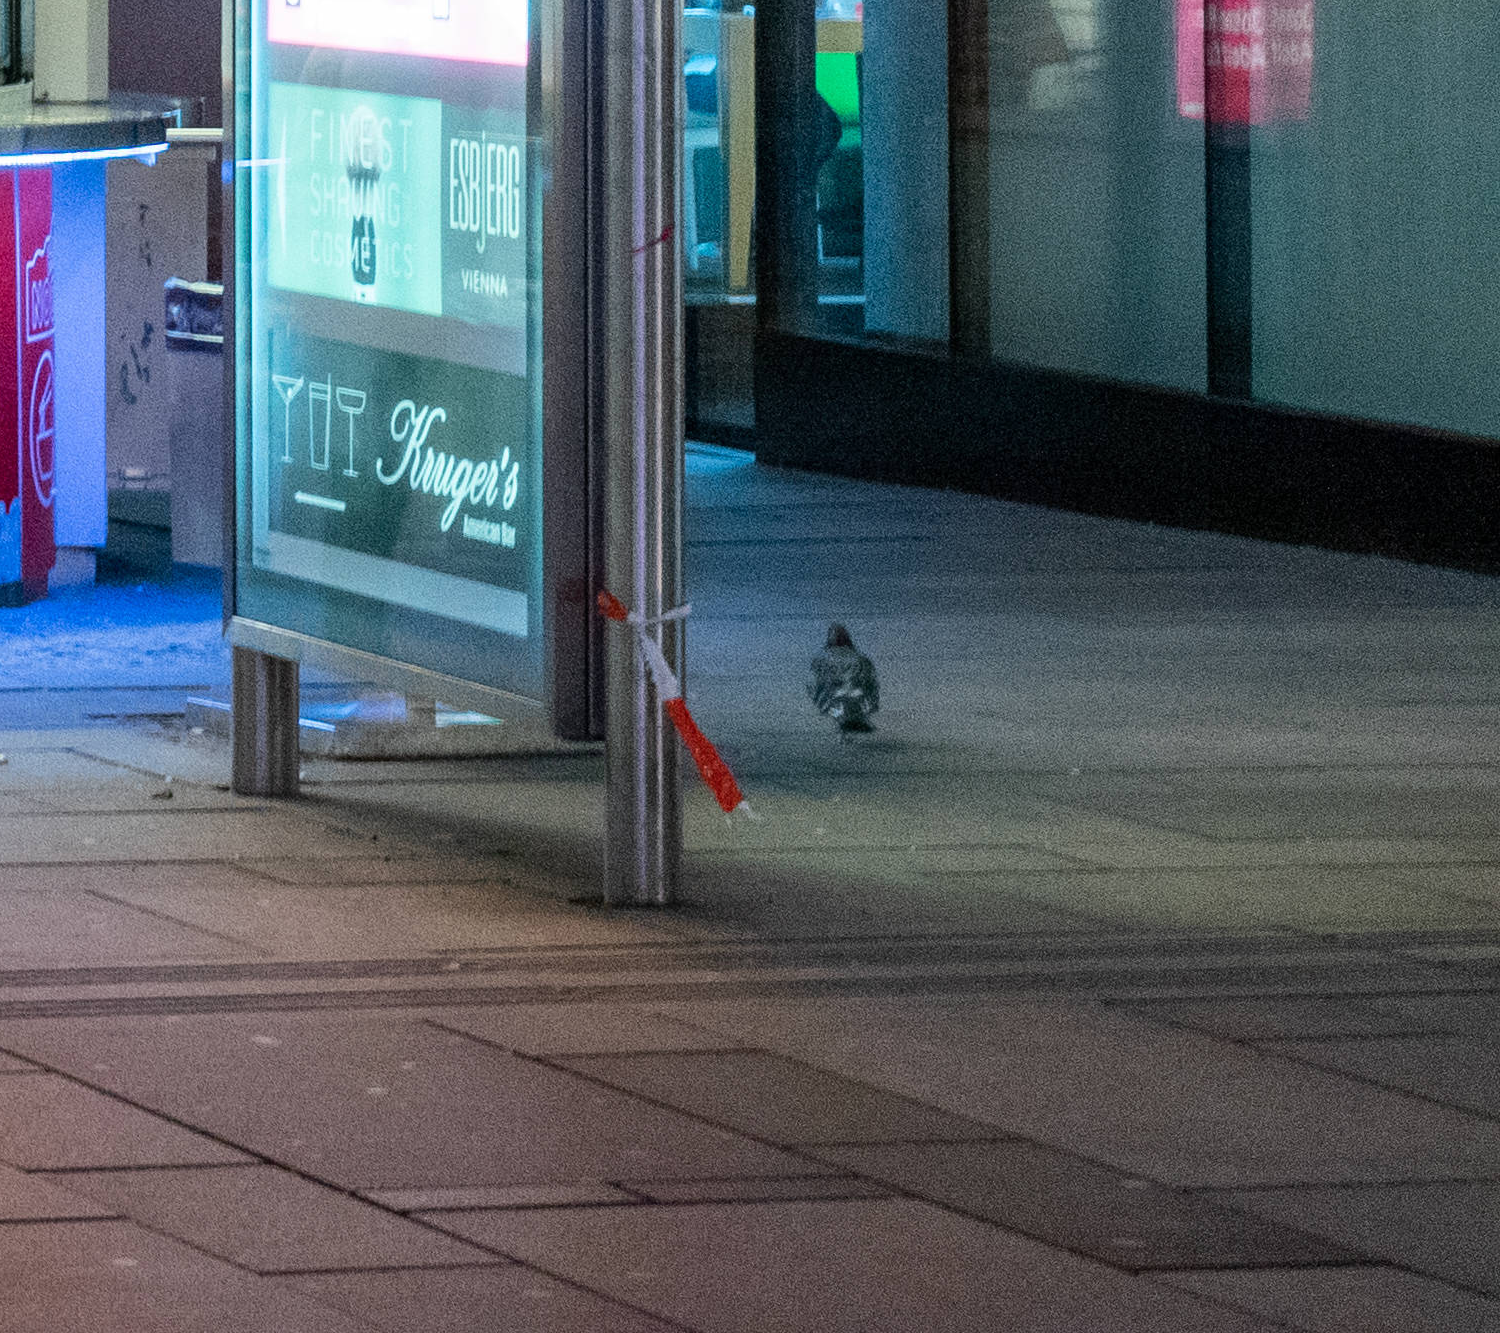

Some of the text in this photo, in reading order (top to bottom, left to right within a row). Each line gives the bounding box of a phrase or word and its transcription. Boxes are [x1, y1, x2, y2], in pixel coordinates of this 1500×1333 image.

[310, 108, 413, 174] FINEST
[310, 172, 401, 228] SHAVING
[310, 229, 414, 281] COSMETICS
[461, 268, 509, 298] VIENNA
[376, 399, 520, 533] Kruger's
